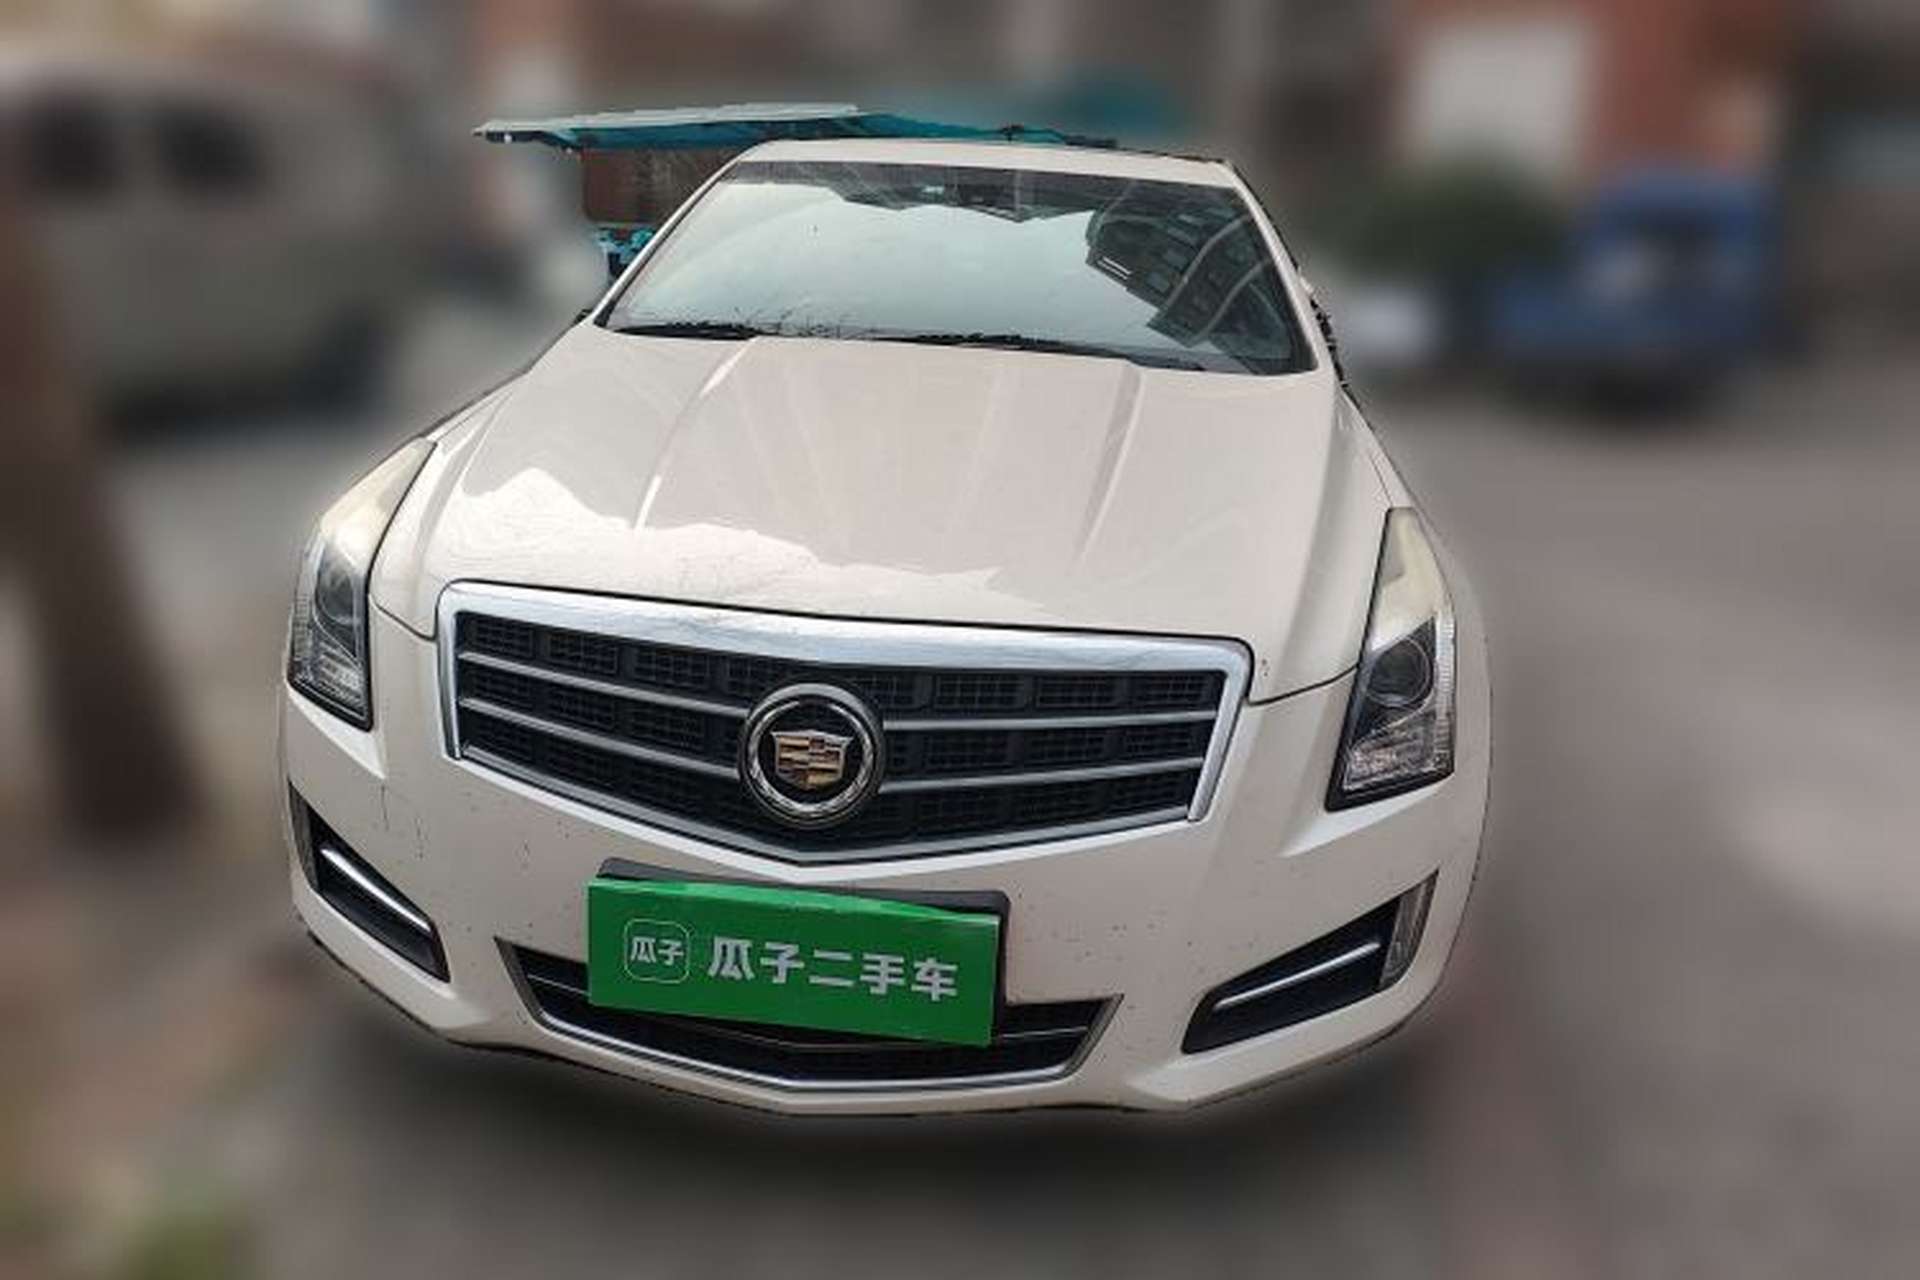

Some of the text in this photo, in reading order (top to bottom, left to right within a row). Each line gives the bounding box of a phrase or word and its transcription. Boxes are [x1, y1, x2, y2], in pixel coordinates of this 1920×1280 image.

[630, 936, 685, 966] 瓜子
[708, 936, 958, 1001] 瓜子二手车
